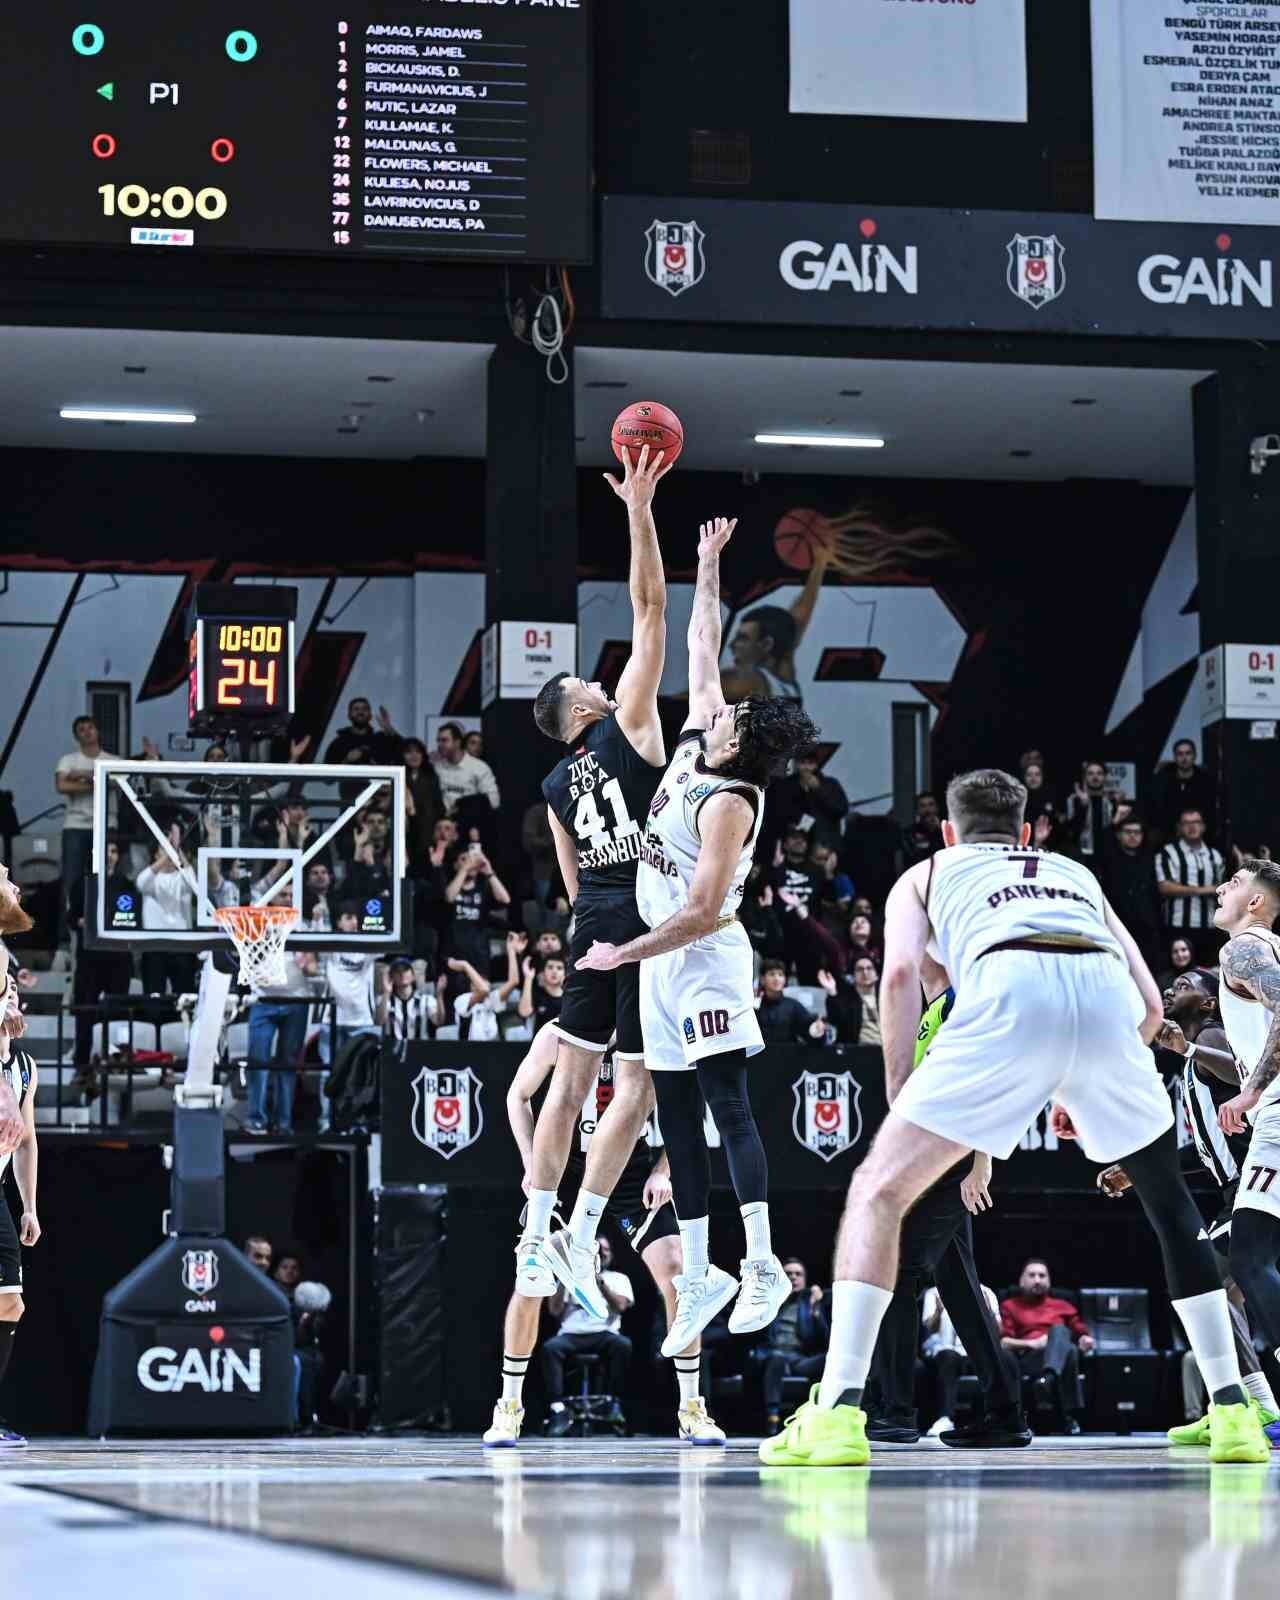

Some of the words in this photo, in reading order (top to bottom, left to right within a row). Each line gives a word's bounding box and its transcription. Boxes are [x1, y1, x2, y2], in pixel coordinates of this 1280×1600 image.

[1165, 17, 1207, 29] BENGÜ
[1210, 18, 1242, 30] TÜRK
[72, 24, 104, 55] 0
[416, 26, 482, 40] FARDAWS
[1175, 31, 1231, 43] YASEMİN
[225, 30, 257, 62] 0
[338, 41, 347, 53] 1
[365, 43, 419, 57] MORRIS,
[422, 46, 466, 58] JAMEL
[1192, 44, 1225, 55] ARZU
[338, 60, 348, 73] 2
[1144, 55, 1203, 68] ESMERAL
[1200, 70, 1240, 81] DERYA
[337, 78, 348, 91] 4
[365, 81, 477, 98] FURMANAVICIUS,
[479, 86, 487, 97] J
[1171, 82, 1205, 93] ESRA
[1207, 83, 1248, 95] ERDEN
[150, 83, 179, 105] P1
[337, 97, 348, 110] 6
[365, 100, 410, 114] MUTIC,
[411, 102, 457, 115] LAZAR
[1162, 107, 1231, 120] AMACHREE
[337, 117, 348, 129] 7
[365, 119, 440, 135] KULLAMAE,
[1183, 121, 1233, 132] ANDREA
[92, 133, 116, 158] 0
[333, 136, 350, 149] 12
[365, 138, 442, 154] MALDUNAS,
[211, 138, 235, 162] 0
[333, 155, 350, 168] 22
[365, 157, 431, 172] FLOWERS,
[433, 161, 492, 173] MICHAEL
[333, 174, 350, 187] 24
[425, 179, 470, 192] NOJUS
[1195, 173, 1237, 184] AYSUN
[332, 193, 350, 206] 35
[1236, 187, 1279, 198] KEMER
[98, 184, 228, 219] 10:00
[469, 200, 480, 211] D
[332, 212, 350, 225] 77
[364, 214, 464, 230] DANUSEVICIUS,
[465, 218, 485, 230] PA
[333, 231, 350, 244] 15
[779, 239, 919, 294] GAIN
[1138, 253, 1273, 308] GAIN
[220, 625, 282, 652] 10:00
[525, 629, 552, 649] 0-1
[1248, 651, 1275, 671] 0-1
[218, 658, 276, 705] 24
[574, 777, 641, 849] 41
[1008, 855, 1041, 878] 7
[699, 1009, 730, 1038] 00
[1246, 1165, 1278, 1193] 77
[137, 1346, 261, 1393] GAIN
